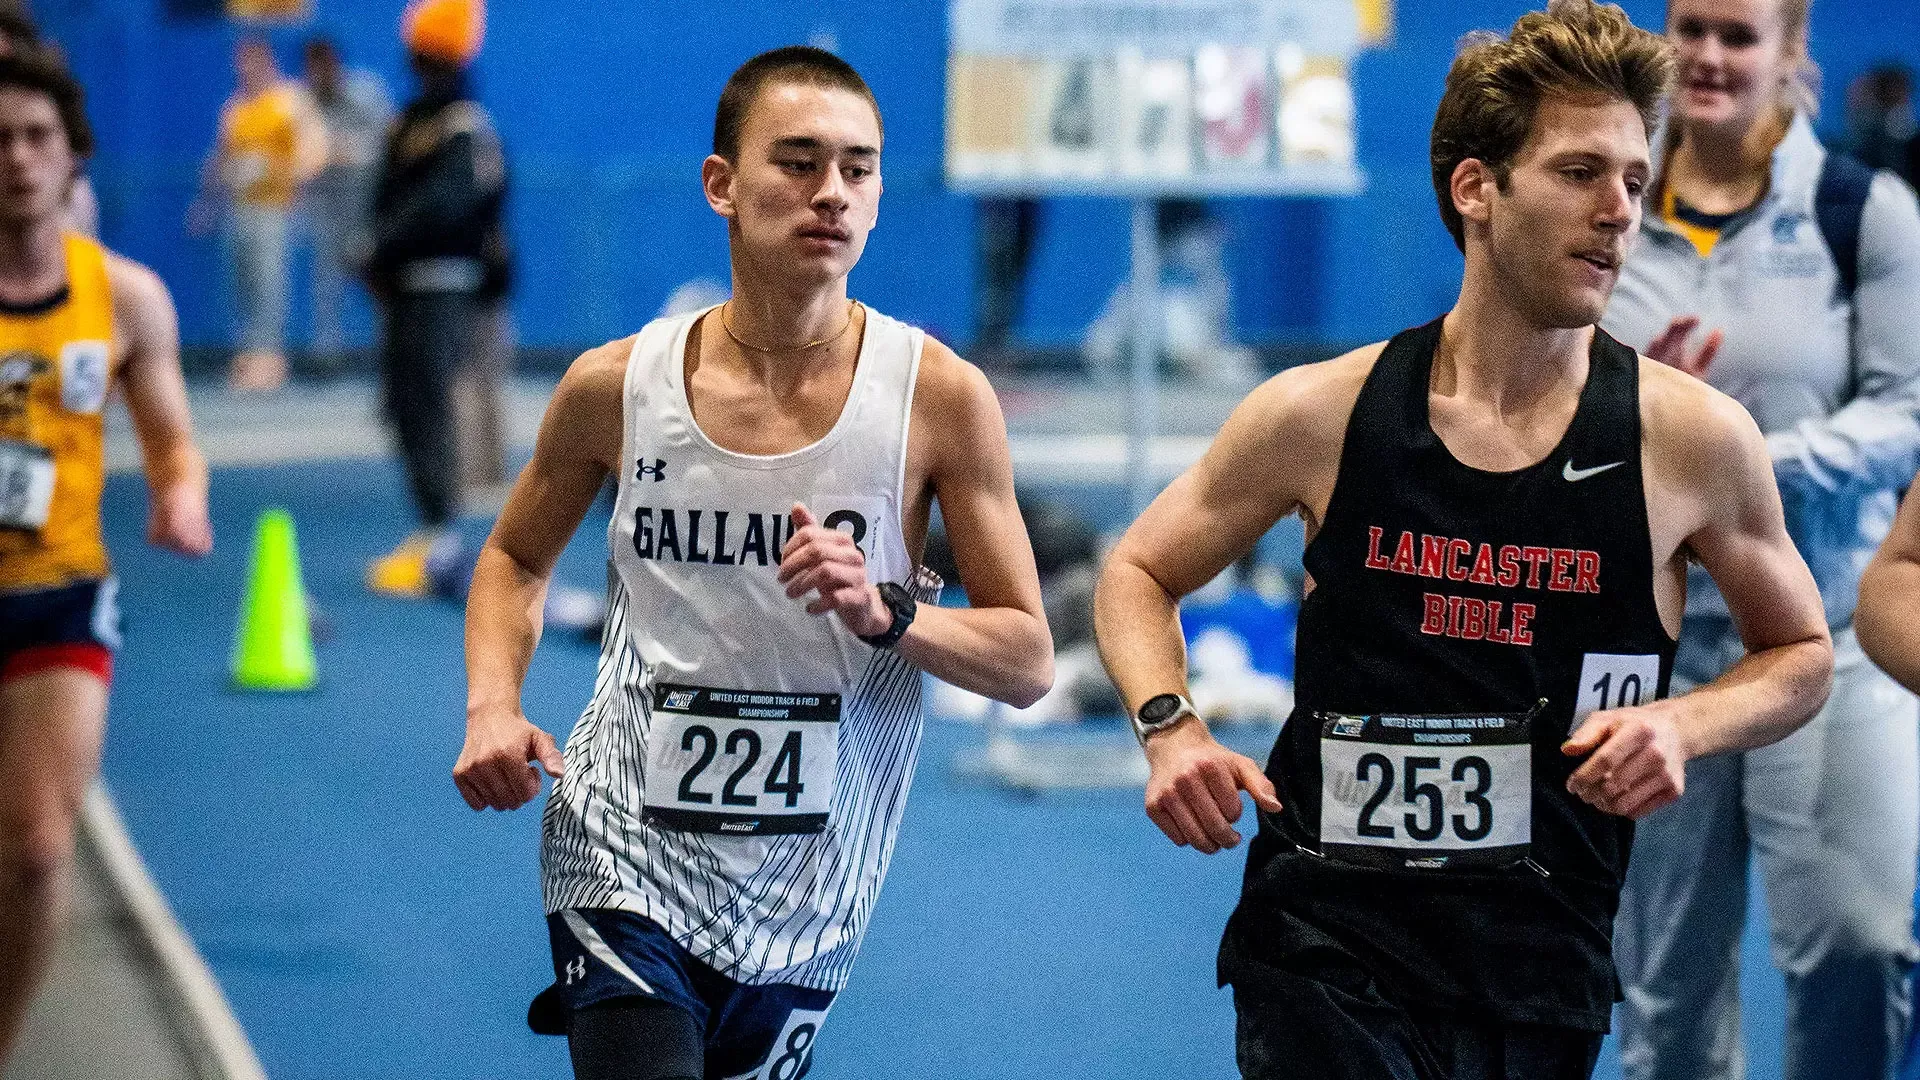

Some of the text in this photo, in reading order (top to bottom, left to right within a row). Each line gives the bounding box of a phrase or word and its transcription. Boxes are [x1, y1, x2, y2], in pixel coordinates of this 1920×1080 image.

[632, 506, 794, 566] GALLAU
[1365, 526, 1601, 594] LANCASTER
[1420, 592, 1536, 646] BIBLE
[710, 692, 733, 703] UNITED
[733, 693, 750, 704] EAST
[750, 695, 774, 705] INDOOR
[775, 696, 796, 706] TRACK
[801, 697, 820, 707] FIELD
[738, 707, 790, 719] CHAMPIONSHIPS
[677, 724, 805, 808] 224
[1356, 752, 1494, 842] 253
[768, 1022, 817, 1080] 8
